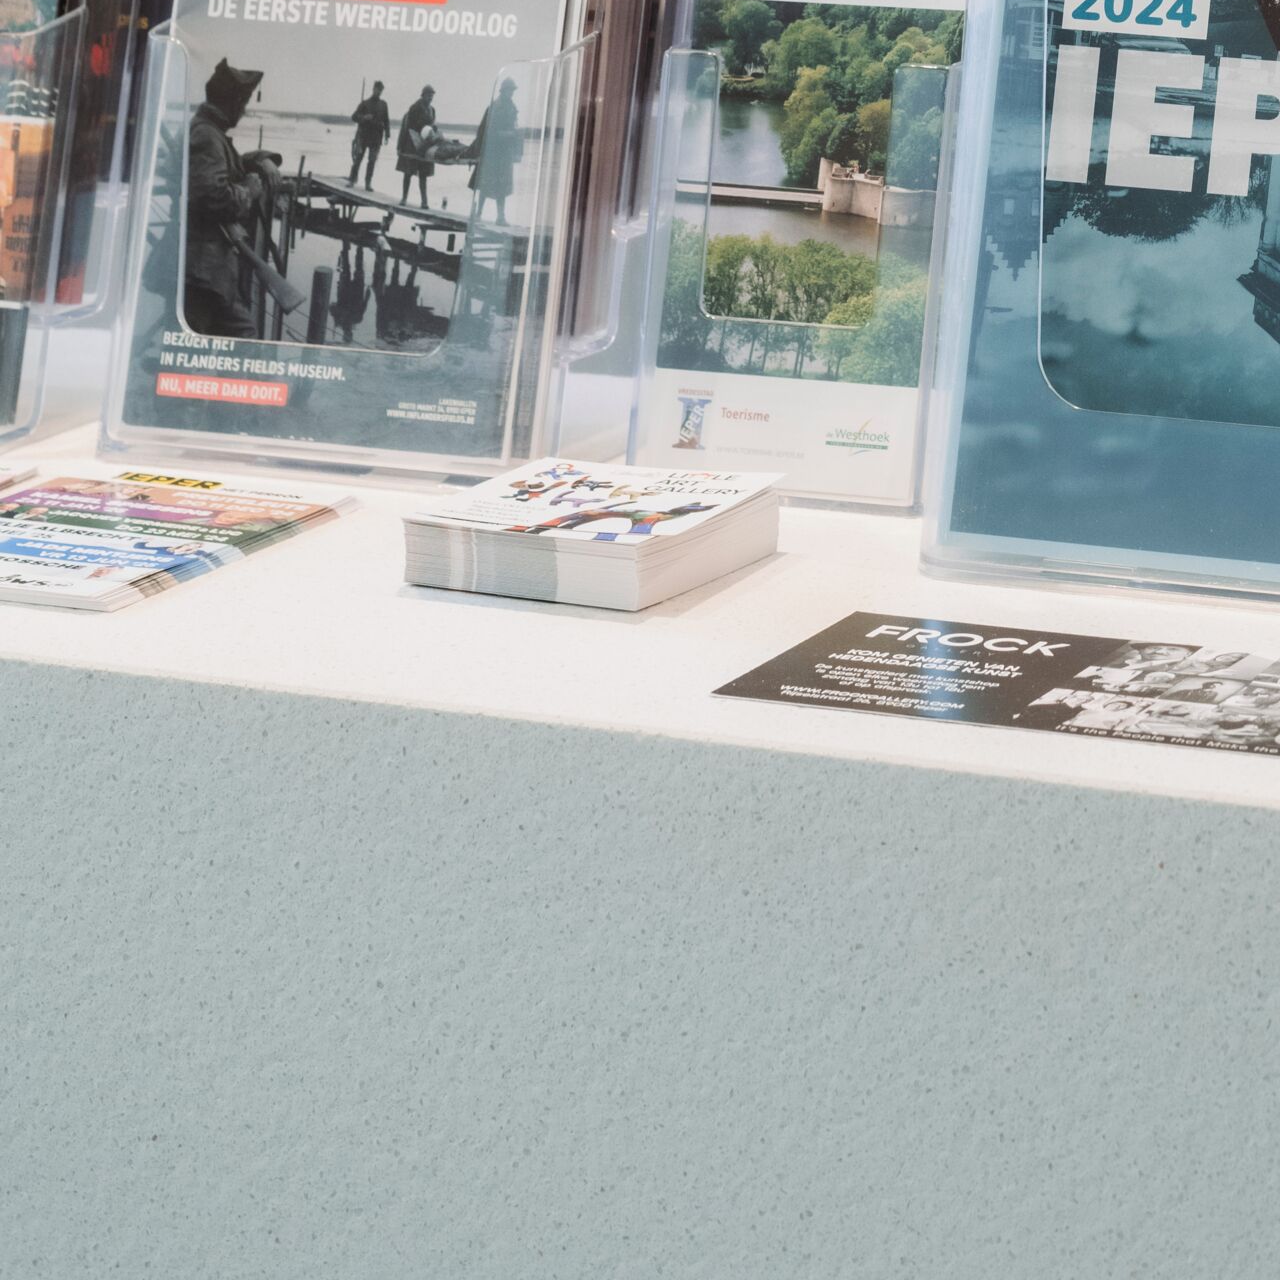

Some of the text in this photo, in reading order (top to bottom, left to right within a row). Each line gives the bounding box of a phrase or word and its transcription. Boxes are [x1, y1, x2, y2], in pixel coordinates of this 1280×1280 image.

[335, 2, 518, 38] WERELDOORLOG
[163, 331, 209, 350] BEZOEK
[160, 352, 345, 381] IN FLANDERS FIELDS MUSEUM.
[160, 376, 282, 401] NU, MEER DAN OOIT.
[721, 407, 770, 422] Toerisme
[835, 428, 890, 442] Westhoek
[644, 486, 747, 495] GALLERY
[866, 624, 1070, 657] FROCK
[828, 652, 961, 672] HEDENDAAGSE
[962, 666, 1023, 679] KUNST
[847, 648, 1020, 672] KOM GENIETEN VAN
